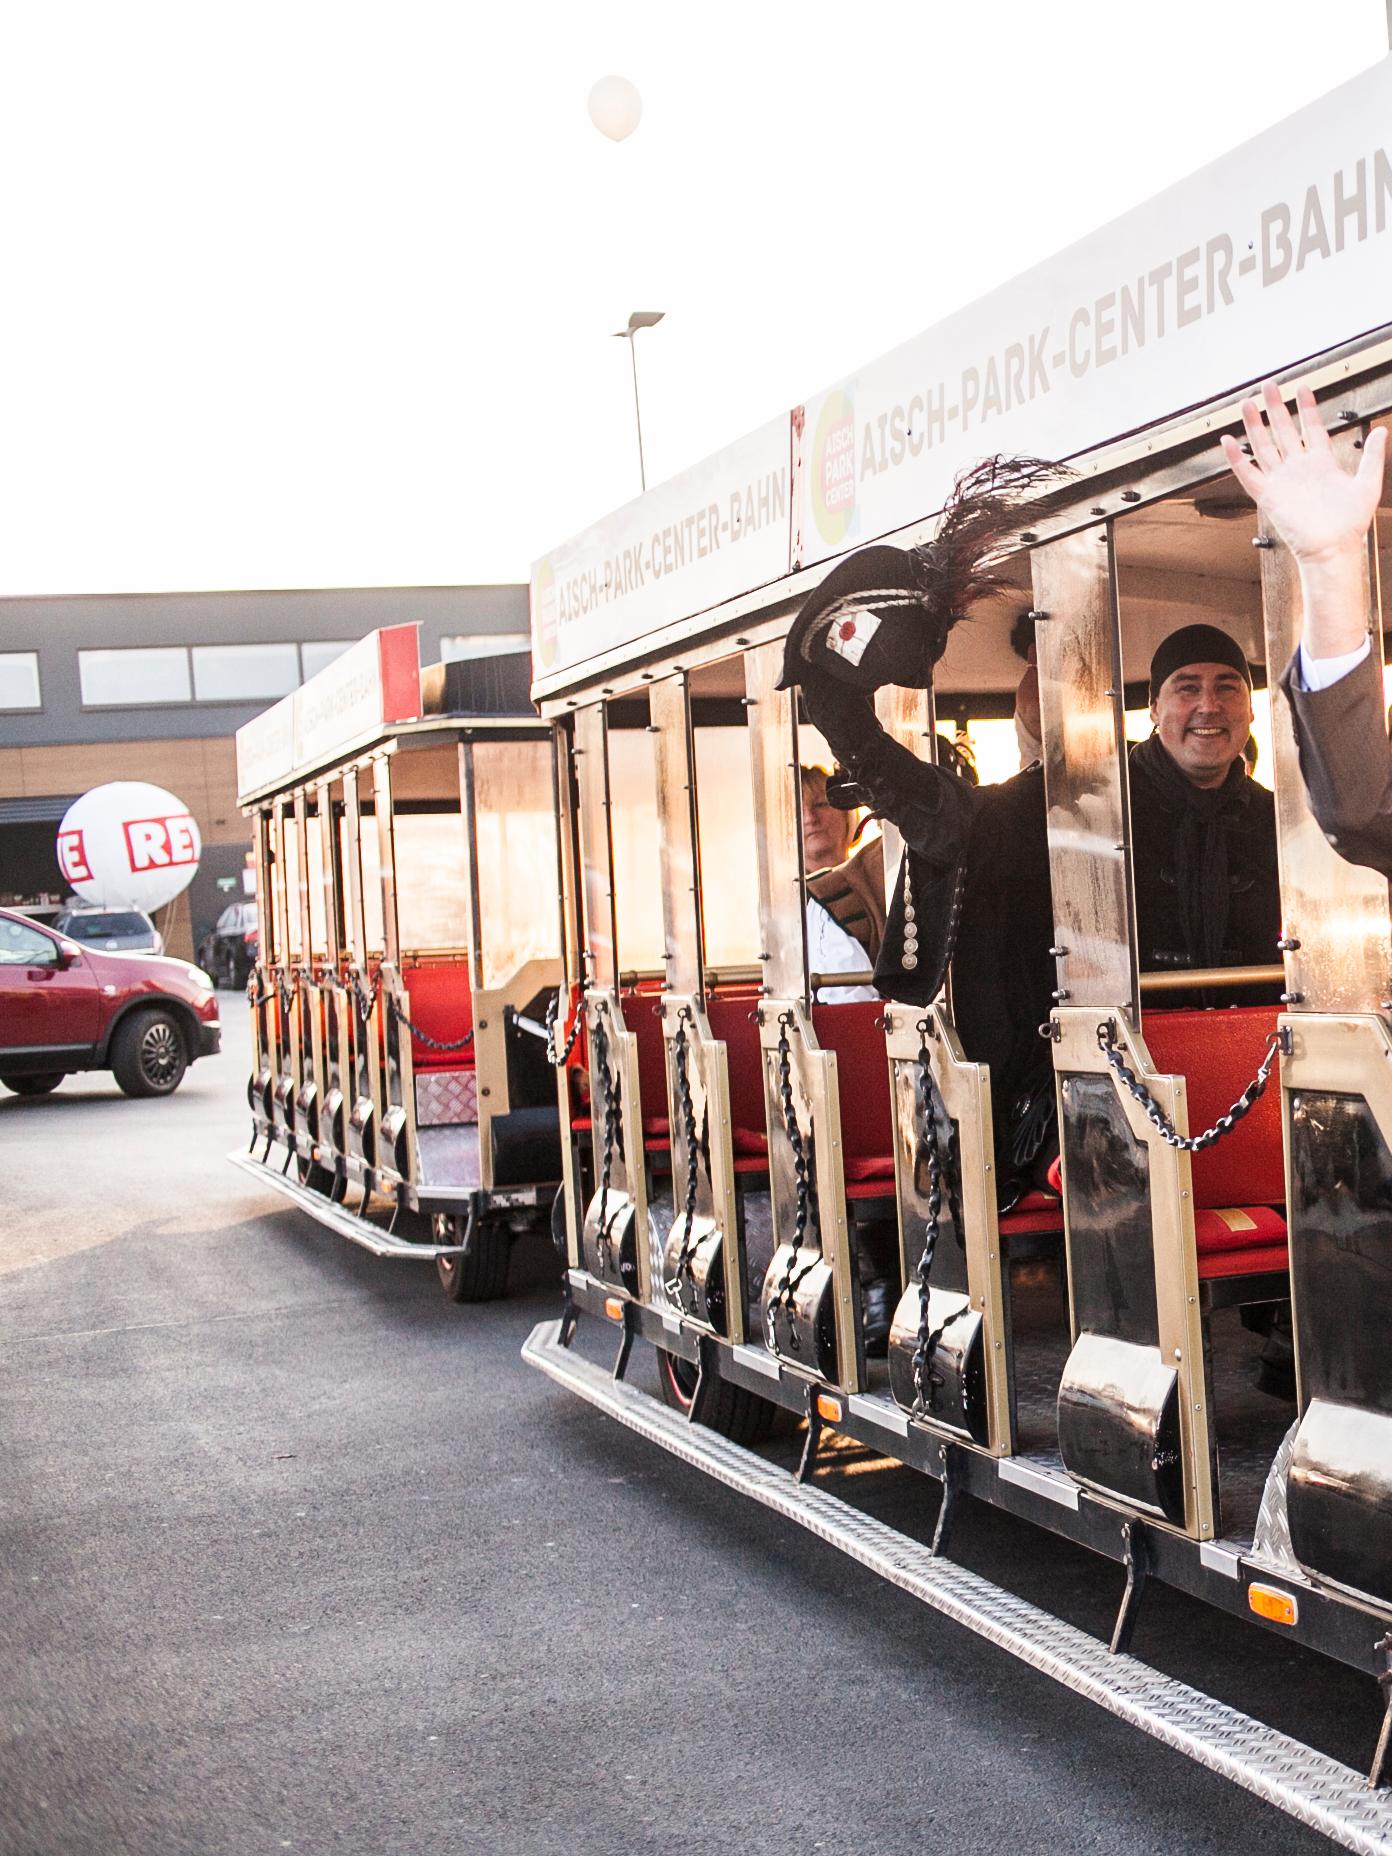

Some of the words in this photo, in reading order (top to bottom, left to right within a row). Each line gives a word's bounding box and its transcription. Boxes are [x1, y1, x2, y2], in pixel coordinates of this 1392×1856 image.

[826, 424, 853, 457] AISCH
[826, 449, 854, 486] PARK
[825, 481, 854, 507] CENTER
[559, 467, 786, 625] AISCH-PARK-CENTER-BAHN
[127, 816, 200, 869] RE
